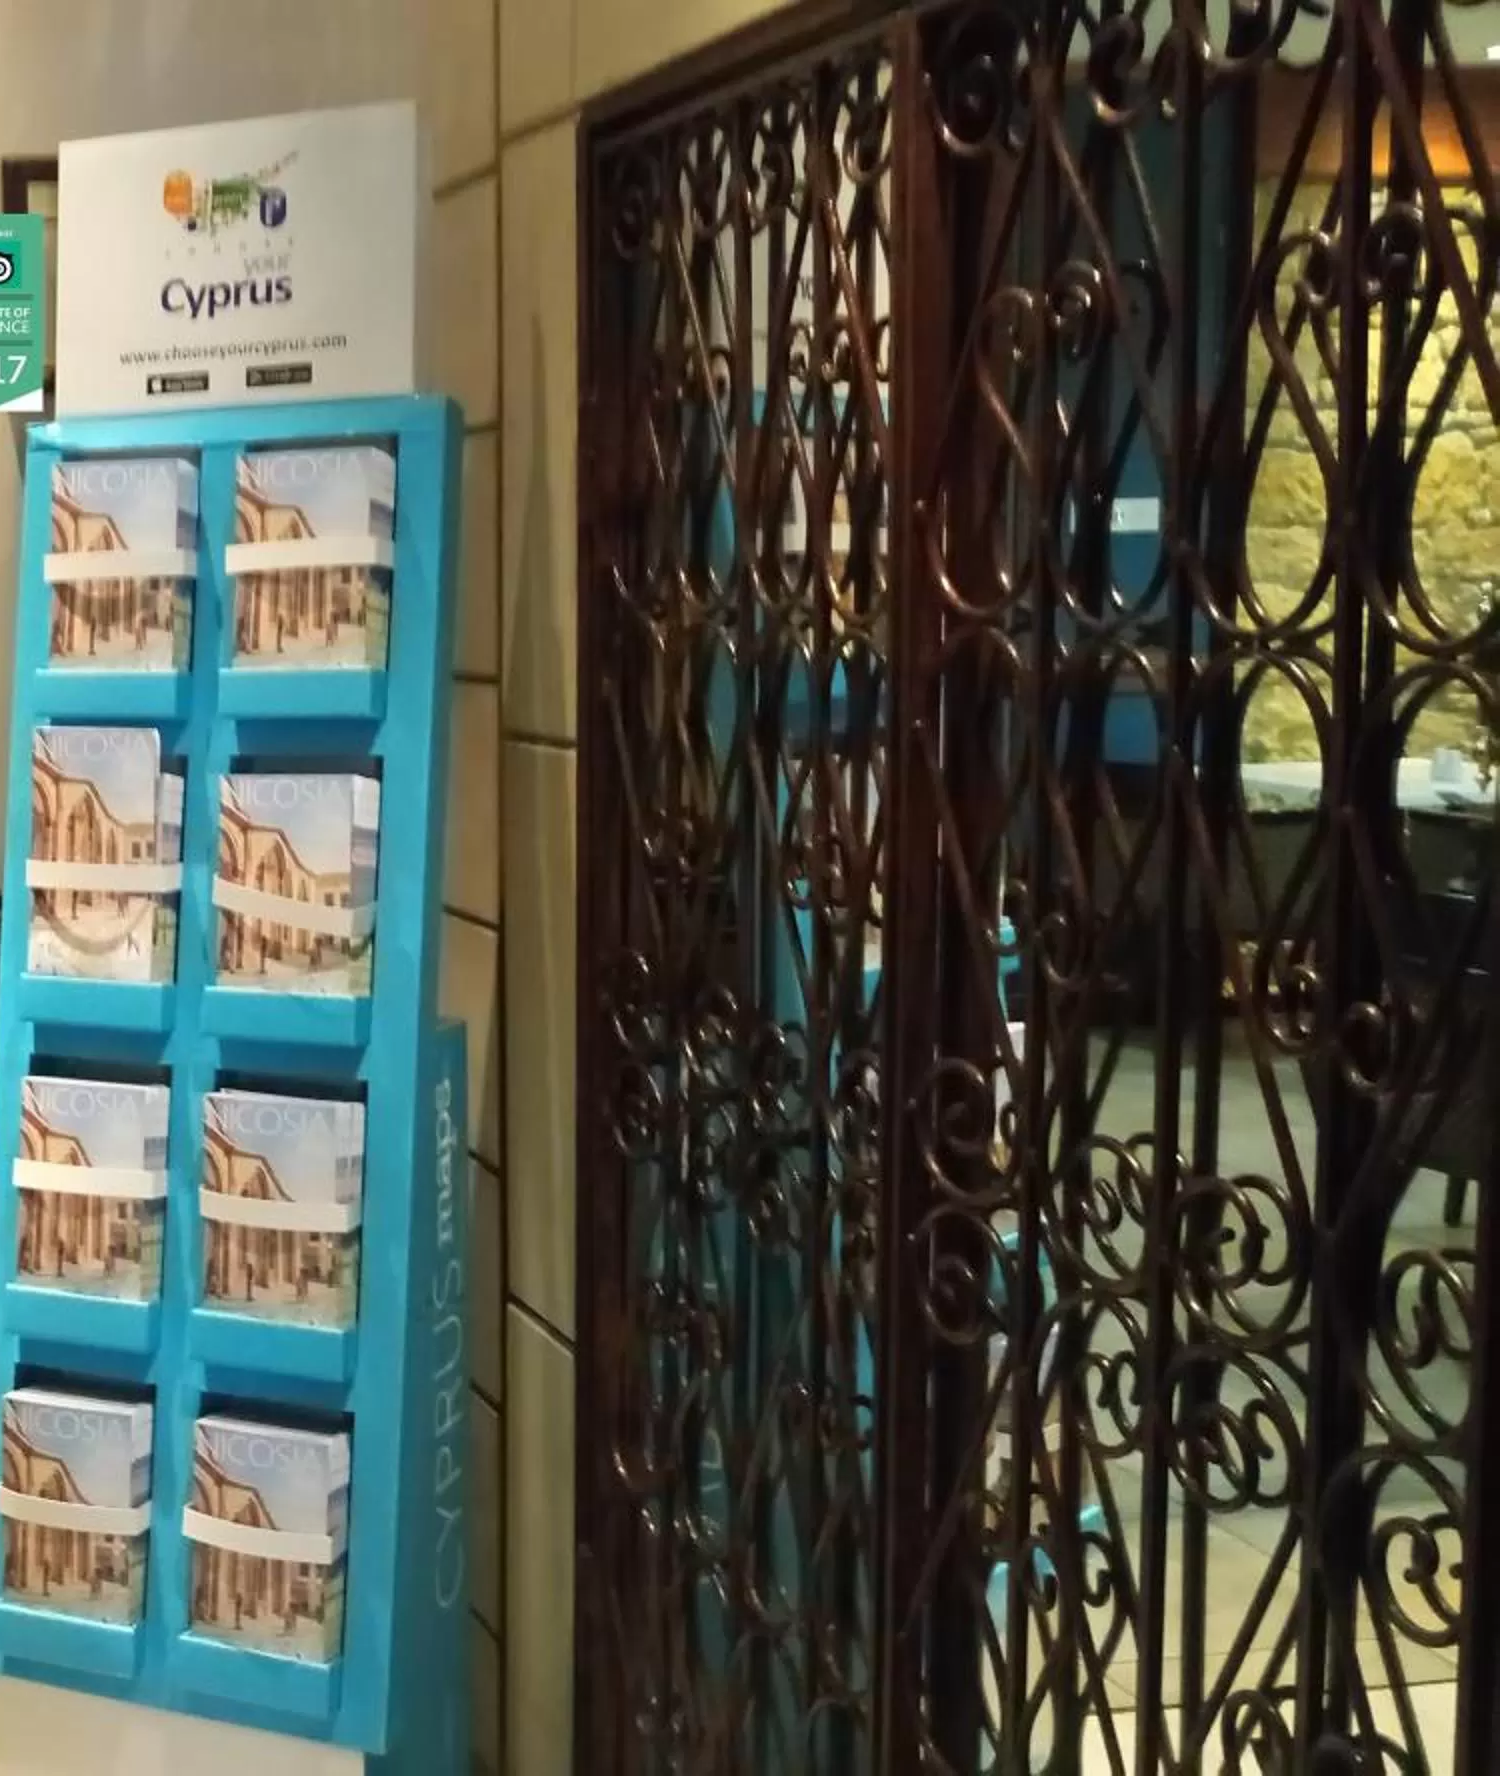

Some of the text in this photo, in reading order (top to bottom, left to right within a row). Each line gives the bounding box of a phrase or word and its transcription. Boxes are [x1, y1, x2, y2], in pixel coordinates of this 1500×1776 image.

[161, 275, 293, 320] Cyprus
[432, 1076, 466, 1610] CYPRUS maps
